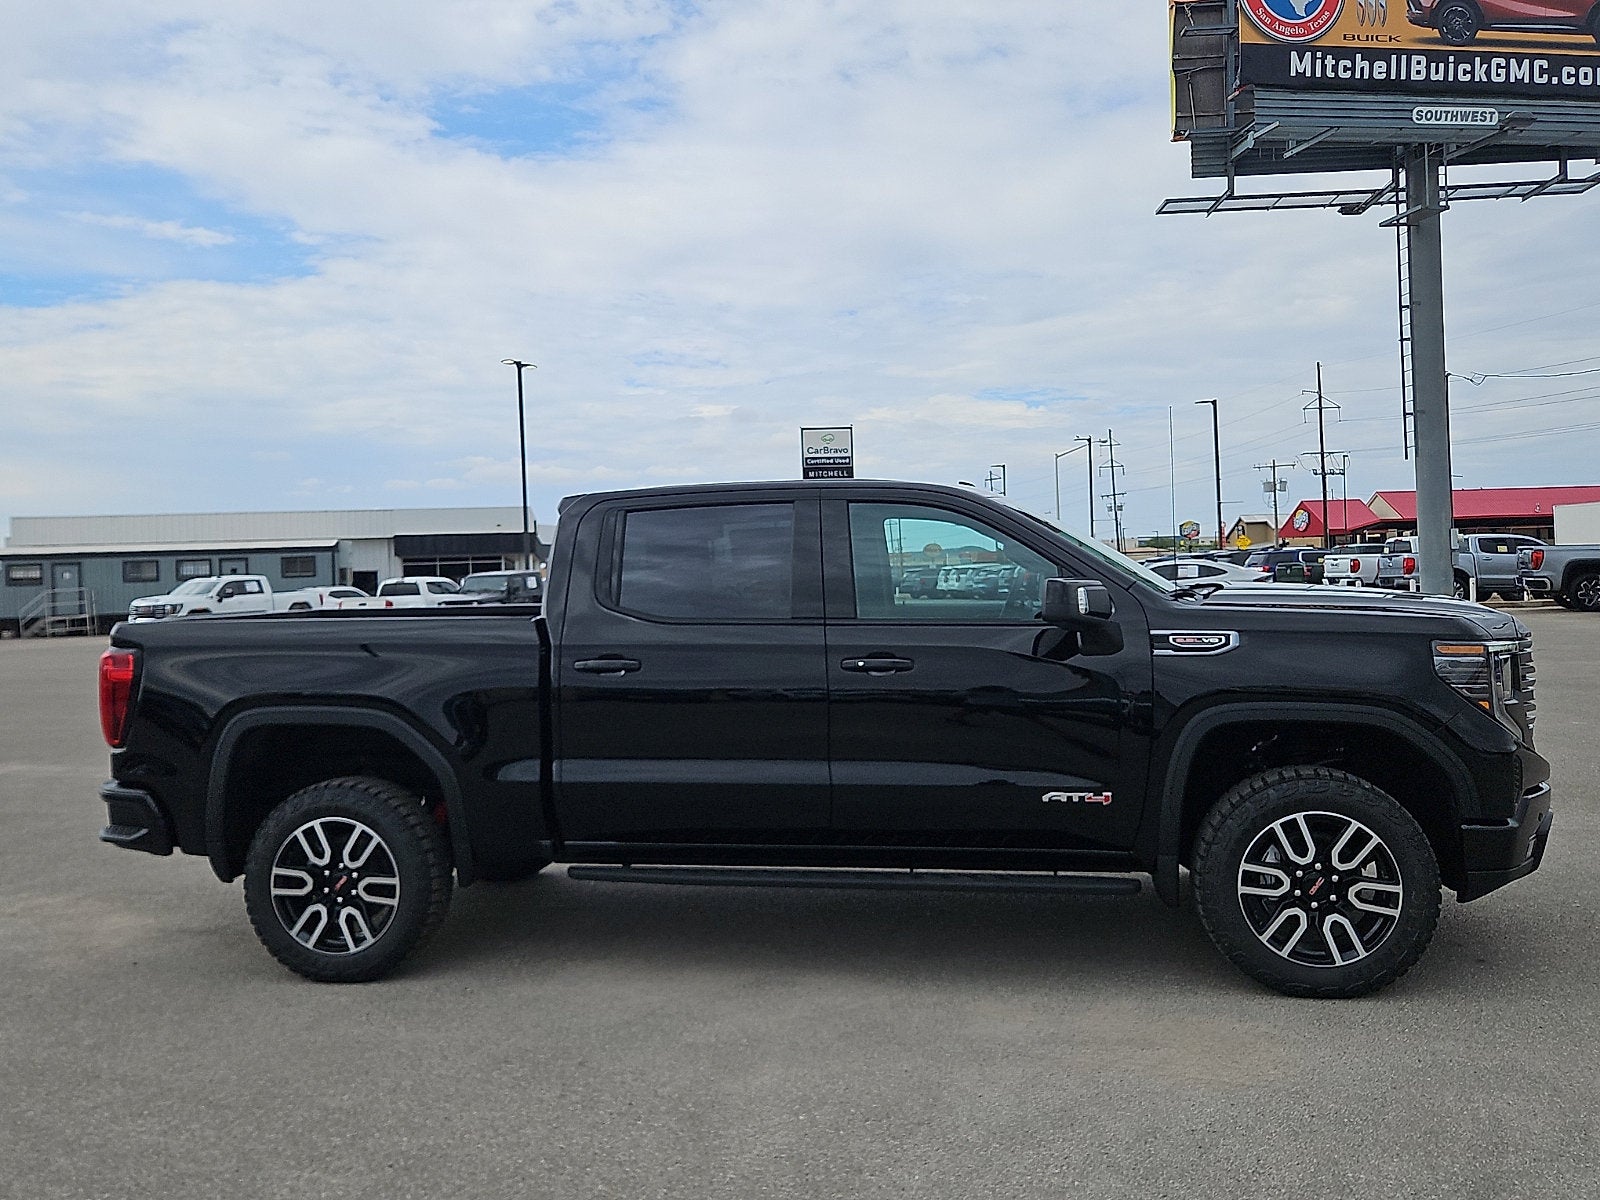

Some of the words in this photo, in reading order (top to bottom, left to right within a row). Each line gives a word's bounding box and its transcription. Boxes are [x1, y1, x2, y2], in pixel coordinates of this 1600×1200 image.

[1256, 7, 1272, 25] San
[1272, 22, 1308, 36] Angelo,
[1308, 11, 1331, 31] Texas
[1342, 33, 1402, 43] BUICK
[1289, 50, 1600, 86] MitchellBuickGMC.co
[1415, 109, 1496, 123] SOUTHWEST
[807, 446, 849, 454] CarBravo
[808, 470, 849, 478] MITCHELL
[1042, 791, 1113, 806] AT4
